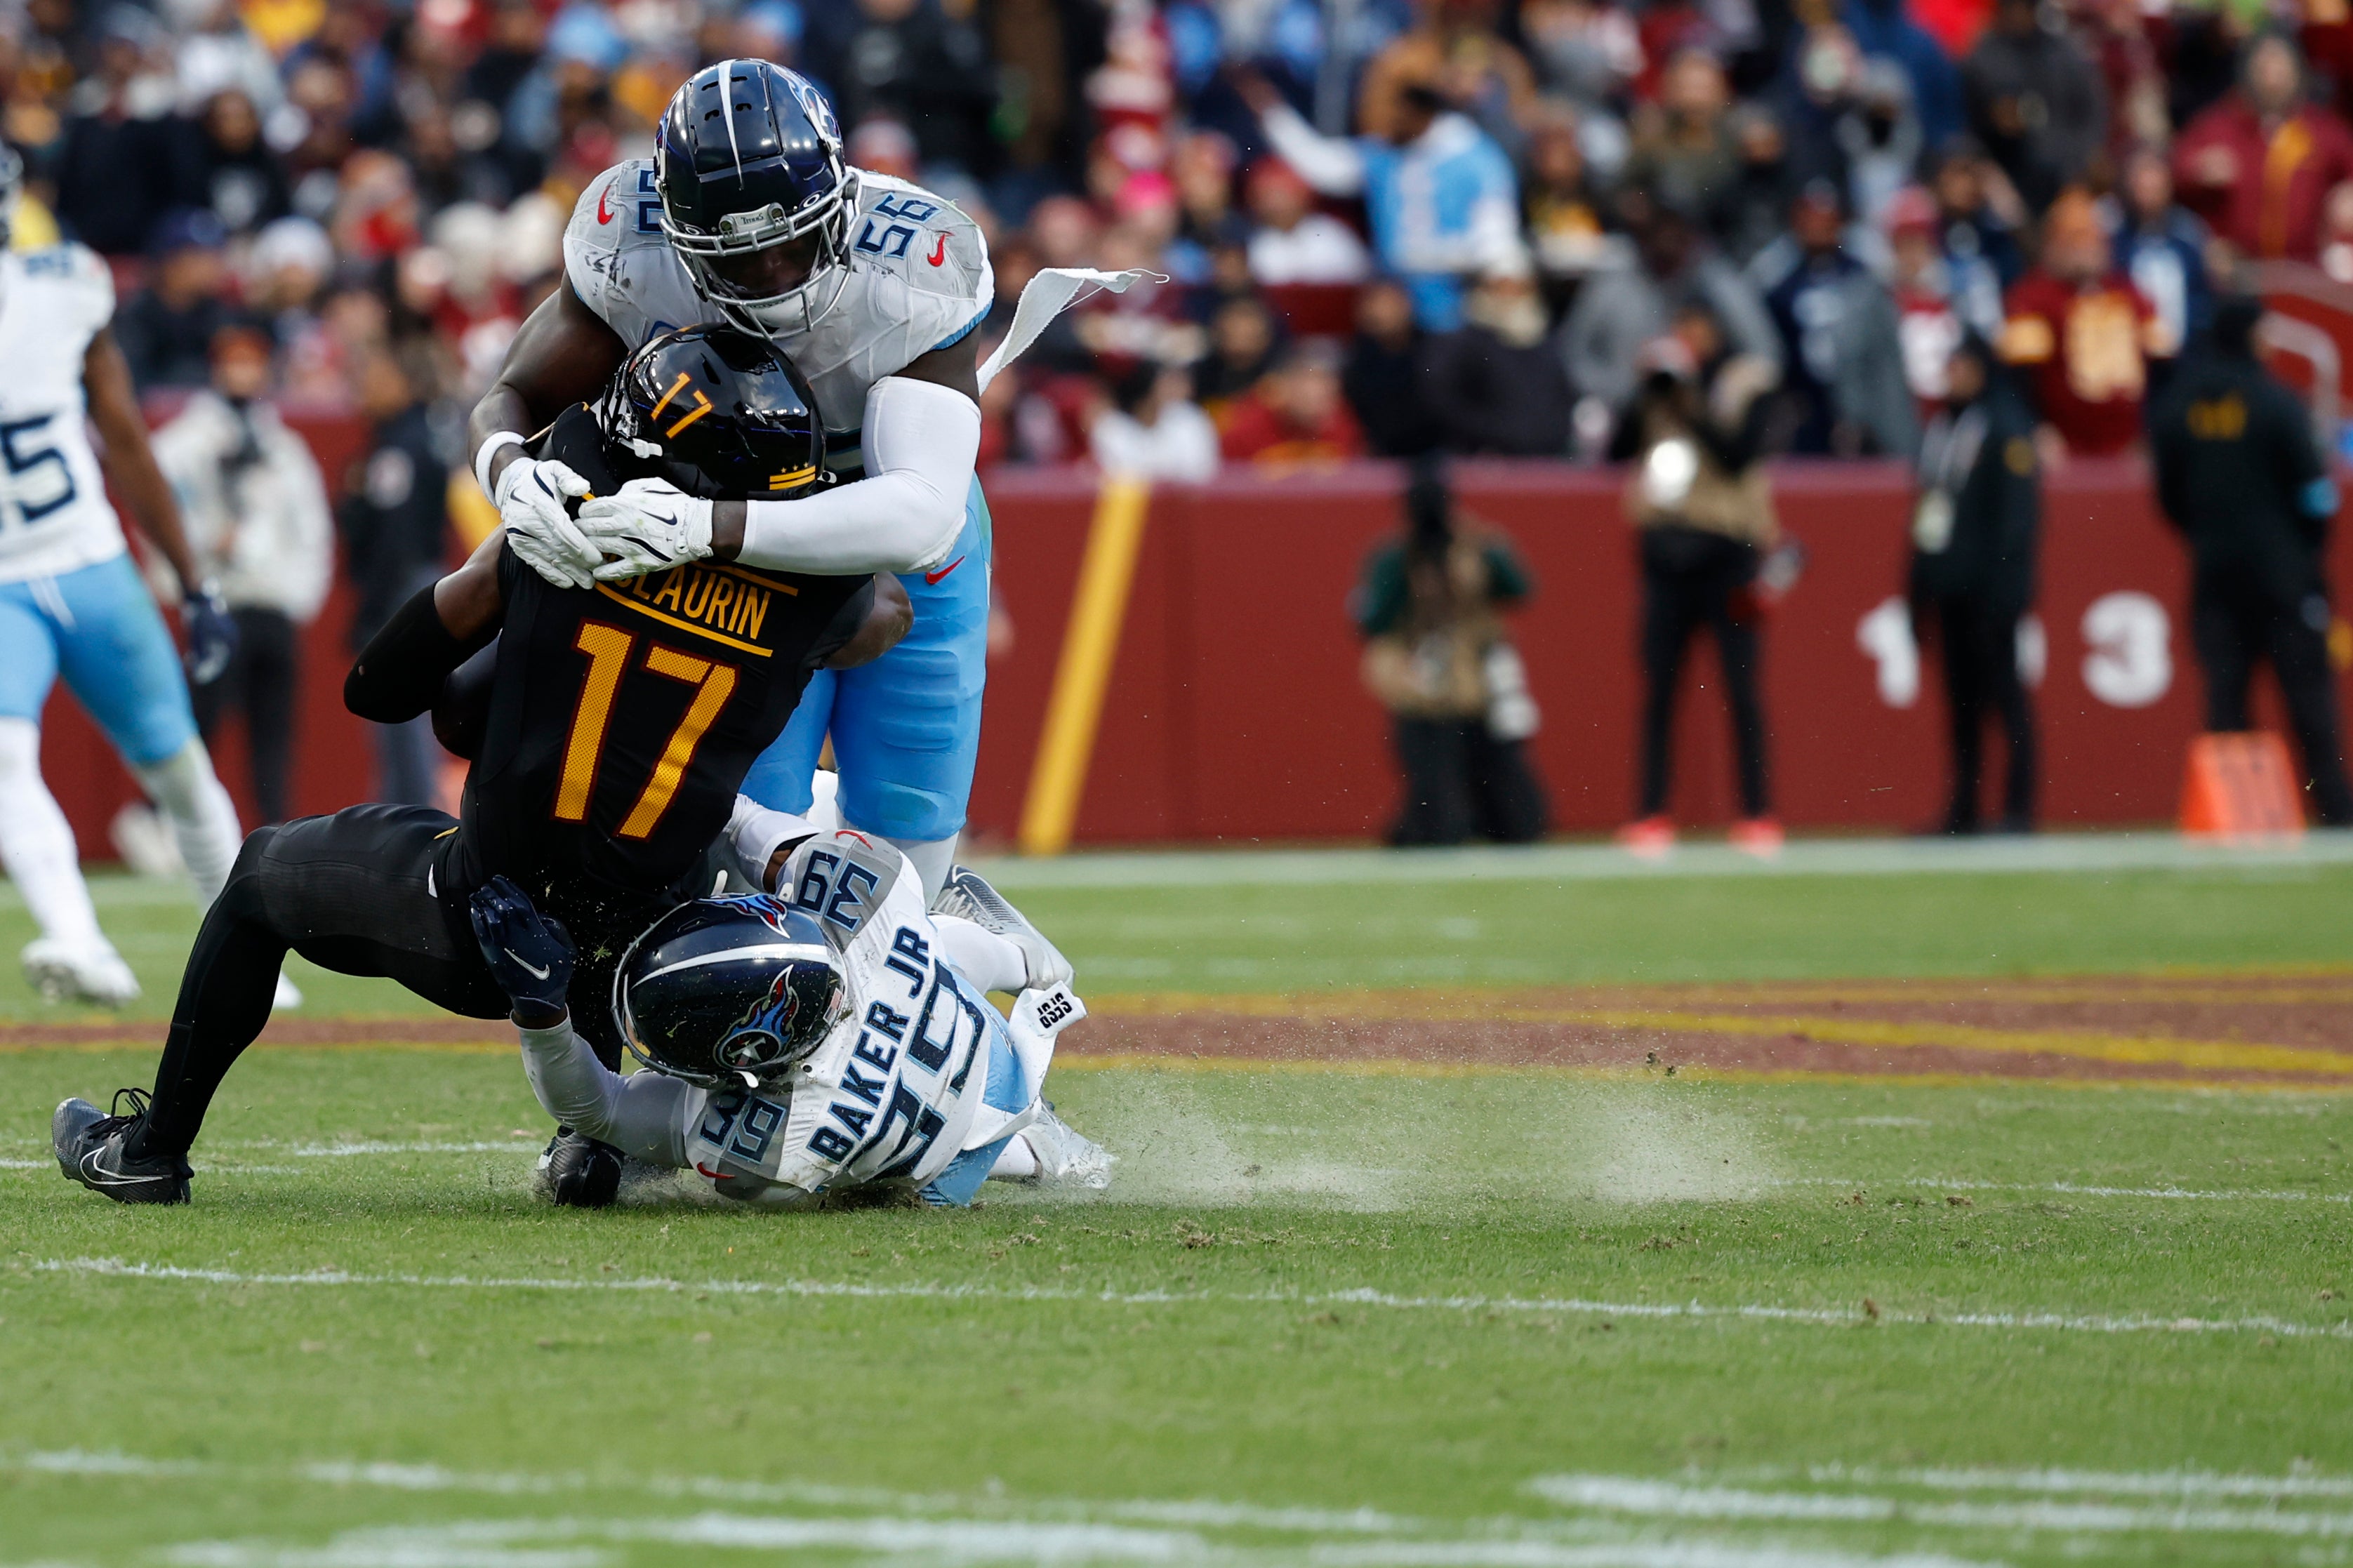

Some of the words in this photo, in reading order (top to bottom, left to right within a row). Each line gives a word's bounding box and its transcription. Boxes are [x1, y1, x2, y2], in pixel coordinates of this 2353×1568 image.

[853, 192, 942, 260] 56
[650, 371, 715, 439] 17
[0, 415, 77, 530] 5
[609, 559, 771, 640] LAURIN
[550, 616, 741, 842] 17
[806, 999, 910, 1164] BAKER
[884, 925, 929, 999] JR
[698, 1089, 786, 1165] 39
